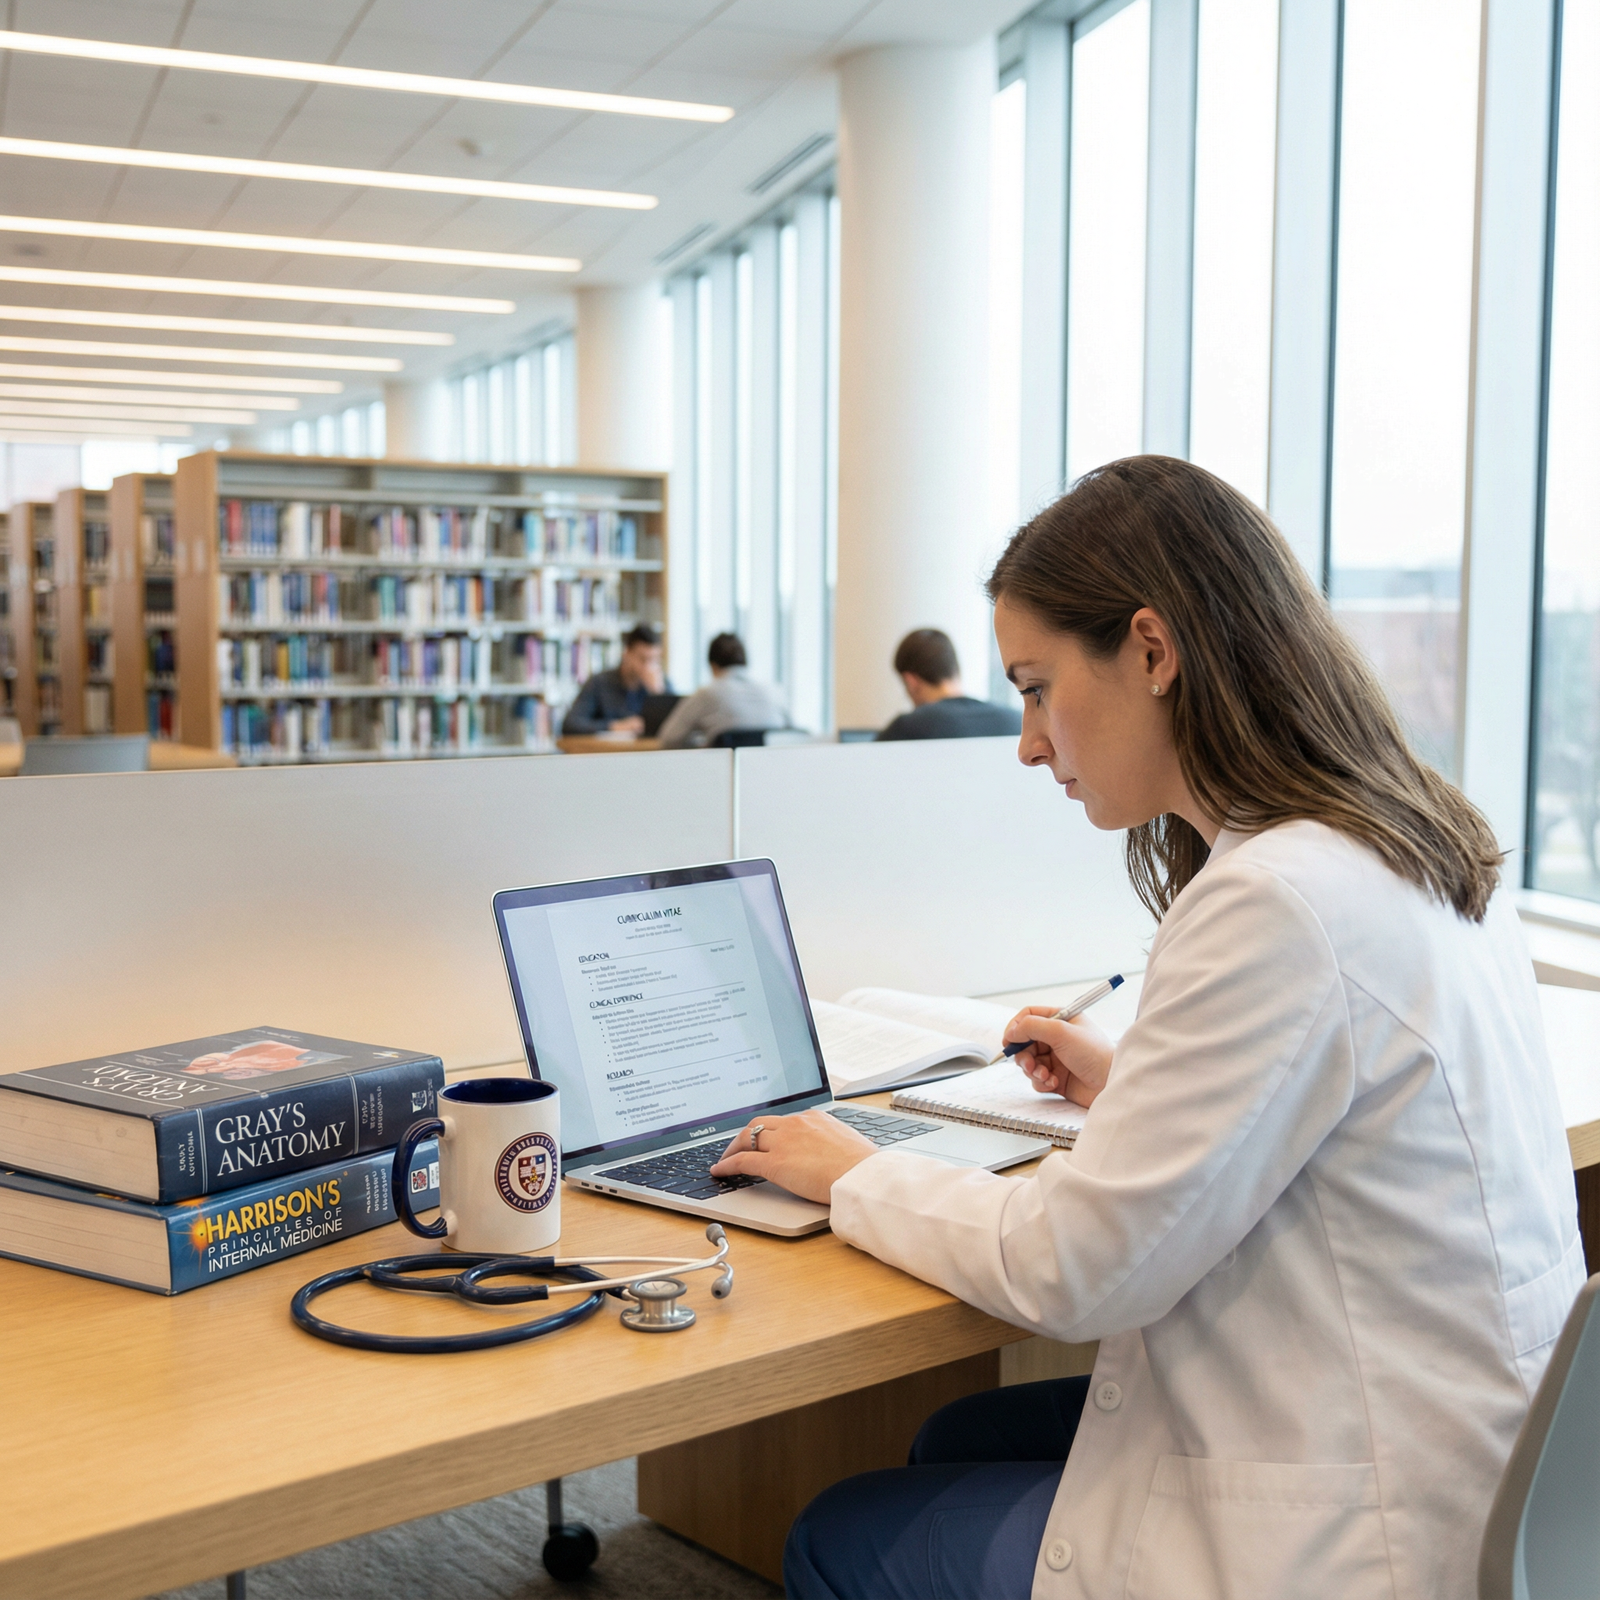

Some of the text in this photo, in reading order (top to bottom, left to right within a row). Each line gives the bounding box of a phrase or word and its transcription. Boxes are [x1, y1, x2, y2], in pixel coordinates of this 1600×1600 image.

[215, 1102, 306, 1144] GRAY'S
[217, 1121, 346, 1177] ANATOMY
[206, 1179, 341, 1244] HARRISON'S
[208, 1207, 342, 1258] PRINCIPLES OF
[208, 1218, 343, 1273] INTERNAL MEDICINE
